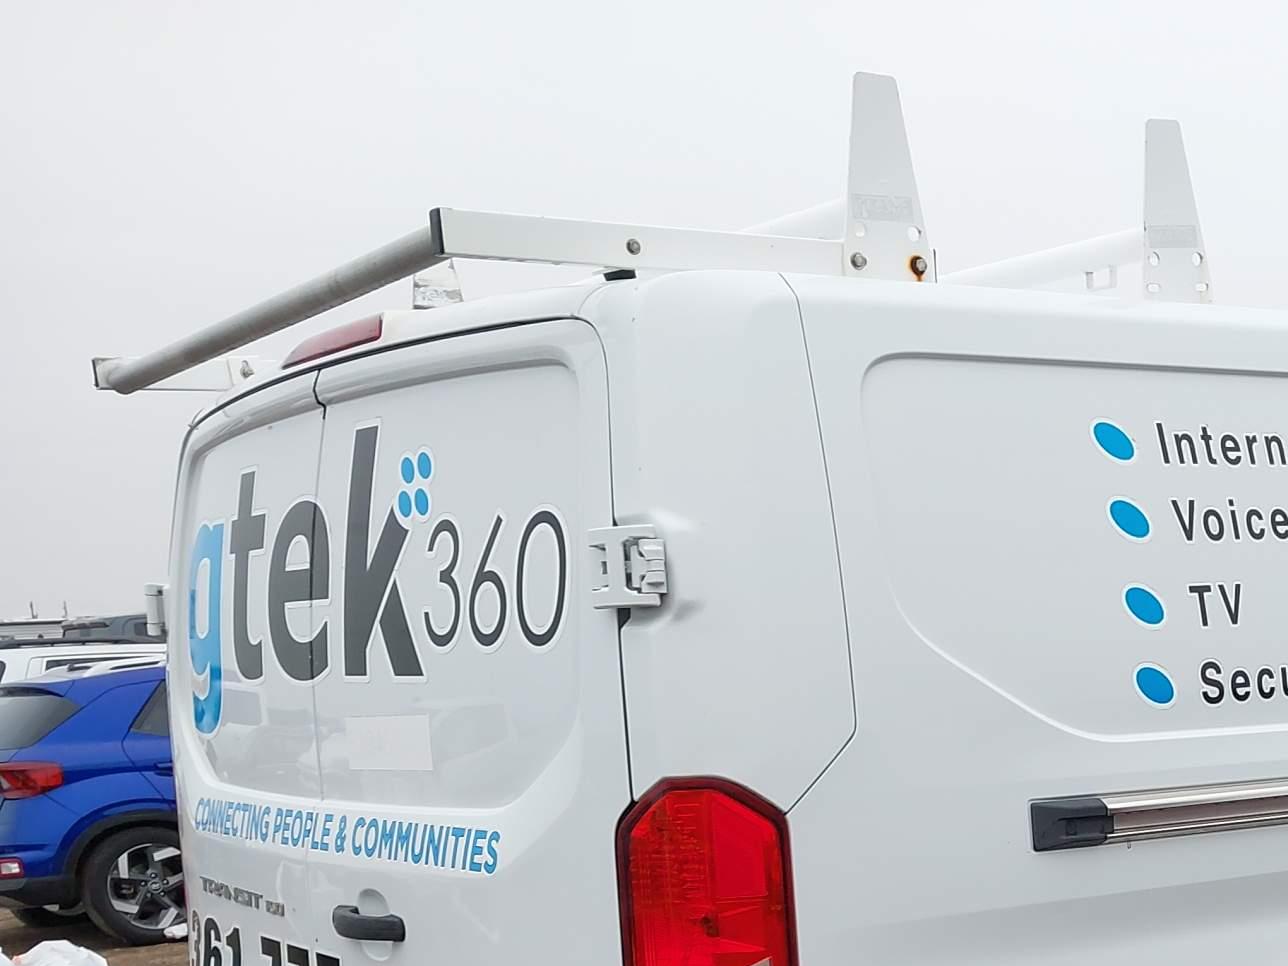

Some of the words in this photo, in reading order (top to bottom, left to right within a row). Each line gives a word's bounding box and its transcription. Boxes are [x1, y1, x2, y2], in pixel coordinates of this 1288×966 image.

[1188, 583, 1242, 627] TV
[194, 797, 271, 843] CONNECTING
[271, 807, 334, 852] PEOPLE
[335, 814, 347, 854] &
[351, 816, 501, 875] COMMUNITIES
